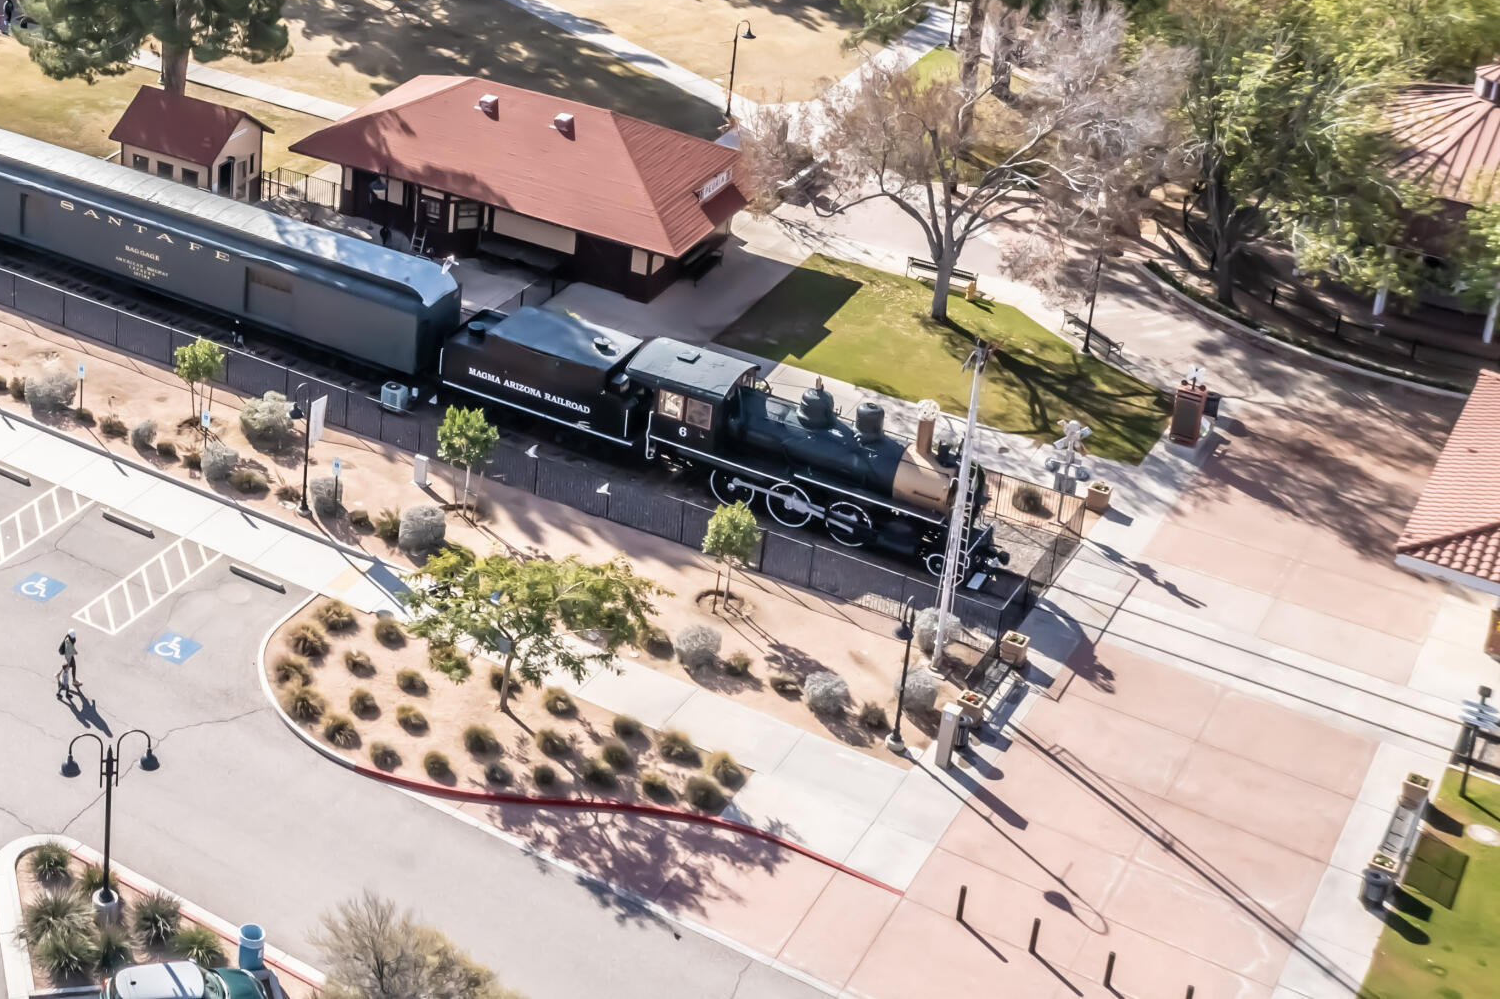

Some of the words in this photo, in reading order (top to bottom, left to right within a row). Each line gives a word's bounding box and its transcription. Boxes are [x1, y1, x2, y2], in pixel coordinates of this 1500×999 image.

[60, 200, 174, 244] SANTA
[189, 241, 231, 262] FE
[125, 244, 160, 262] BAGGAGE
[468, 367, 501, 384] MAGMA
[503, 379, 542, 399] ARIZONA
[544, 392, 591, 414] RAILROAD
[678, 426, 688, 438] 6
